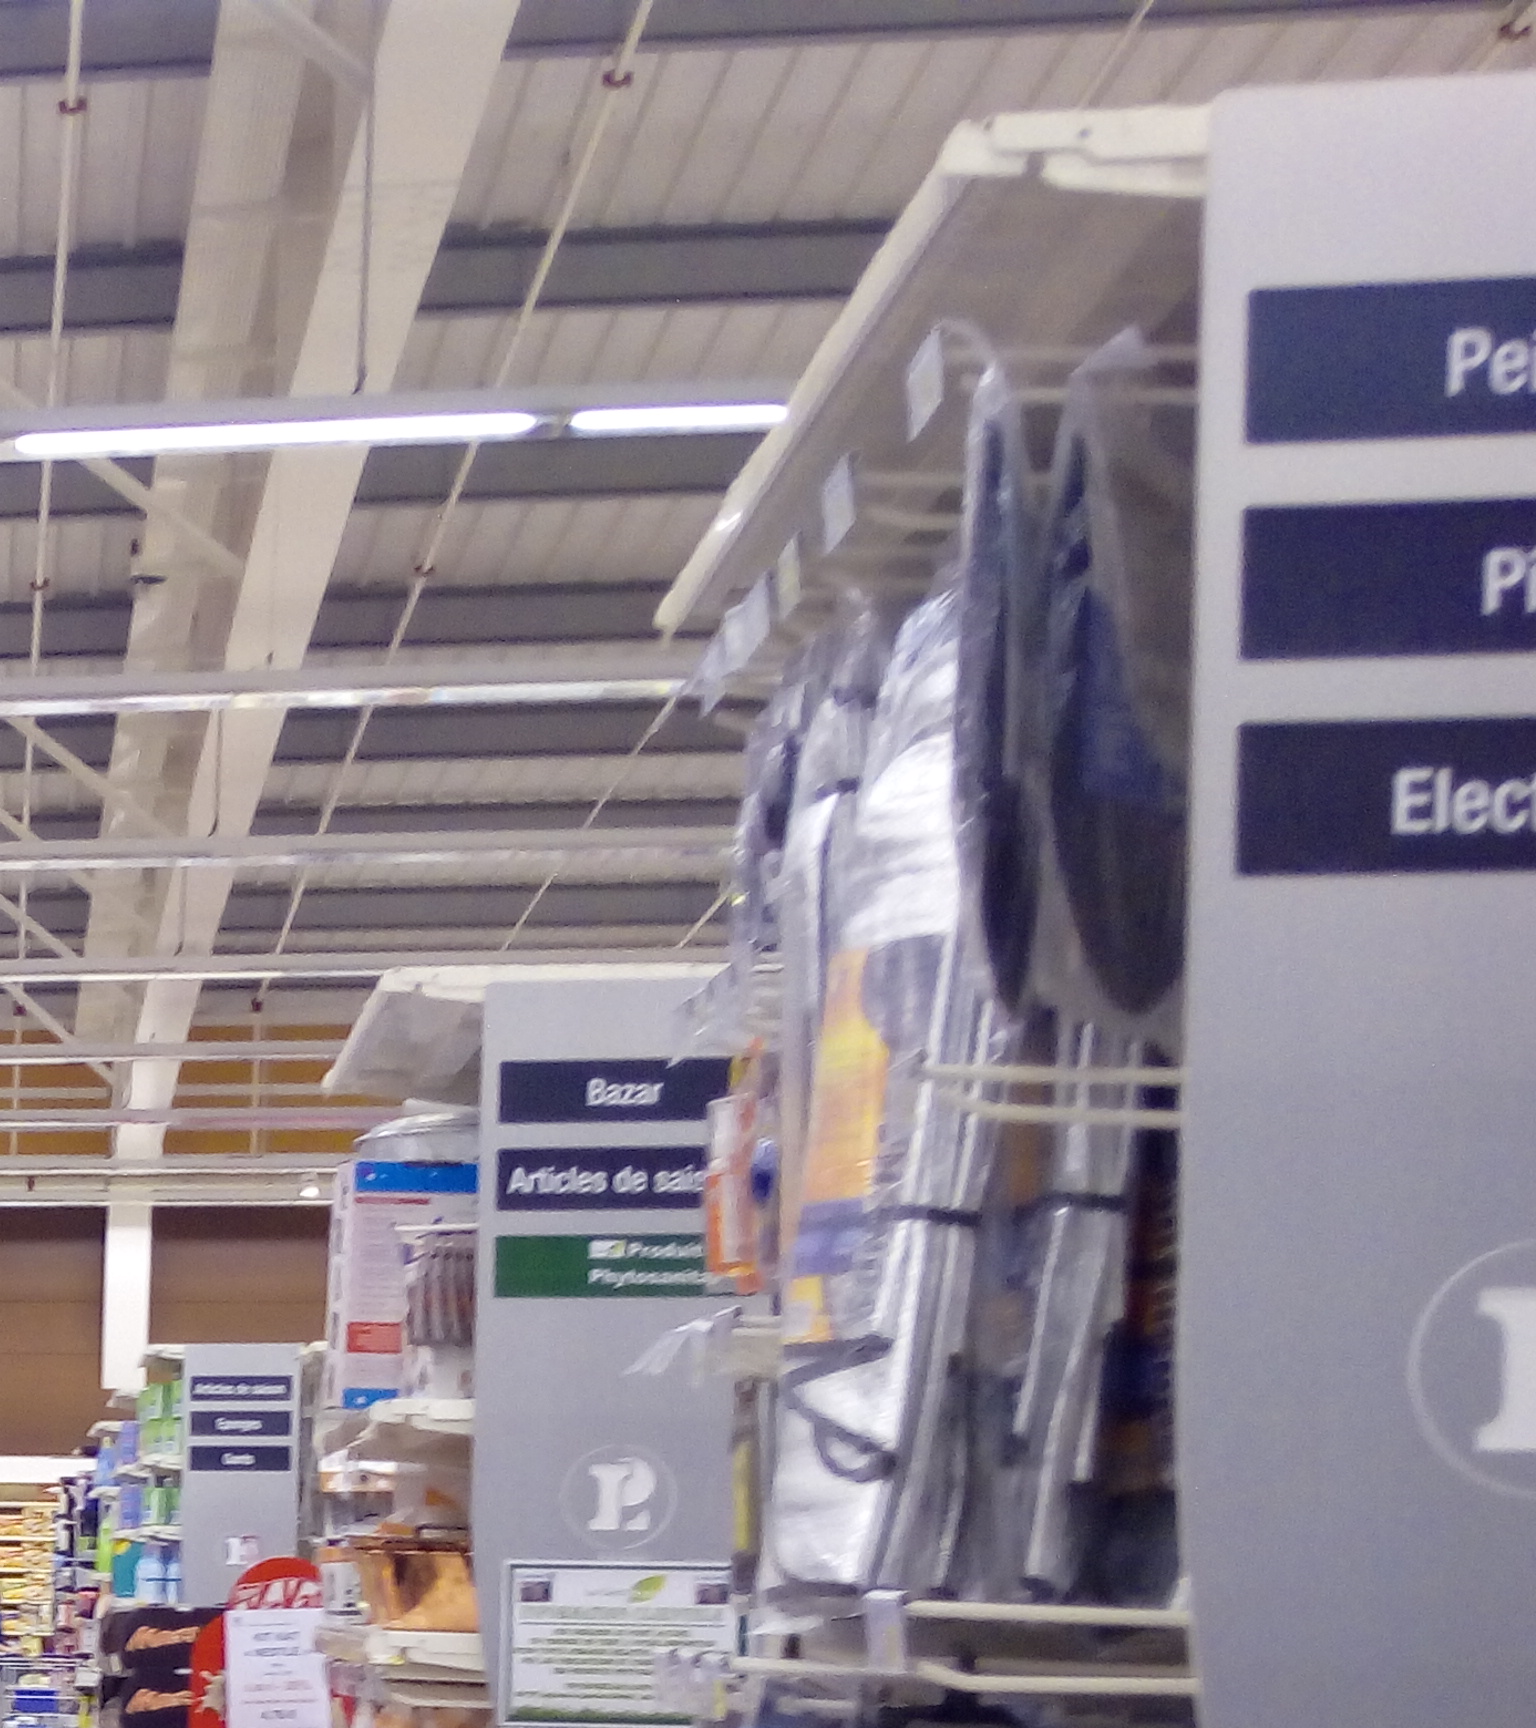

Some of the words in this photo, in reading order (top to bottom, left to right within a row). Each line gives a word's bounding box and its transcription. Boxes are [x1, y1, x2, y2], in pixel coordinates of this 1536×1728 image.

[1441, 326, 1536, 398] Pe
[585, 1077, 664, 1106] Bazar
[506, 1165, 609, 1194] Articles
[611, 1164, 649, 1193] de
